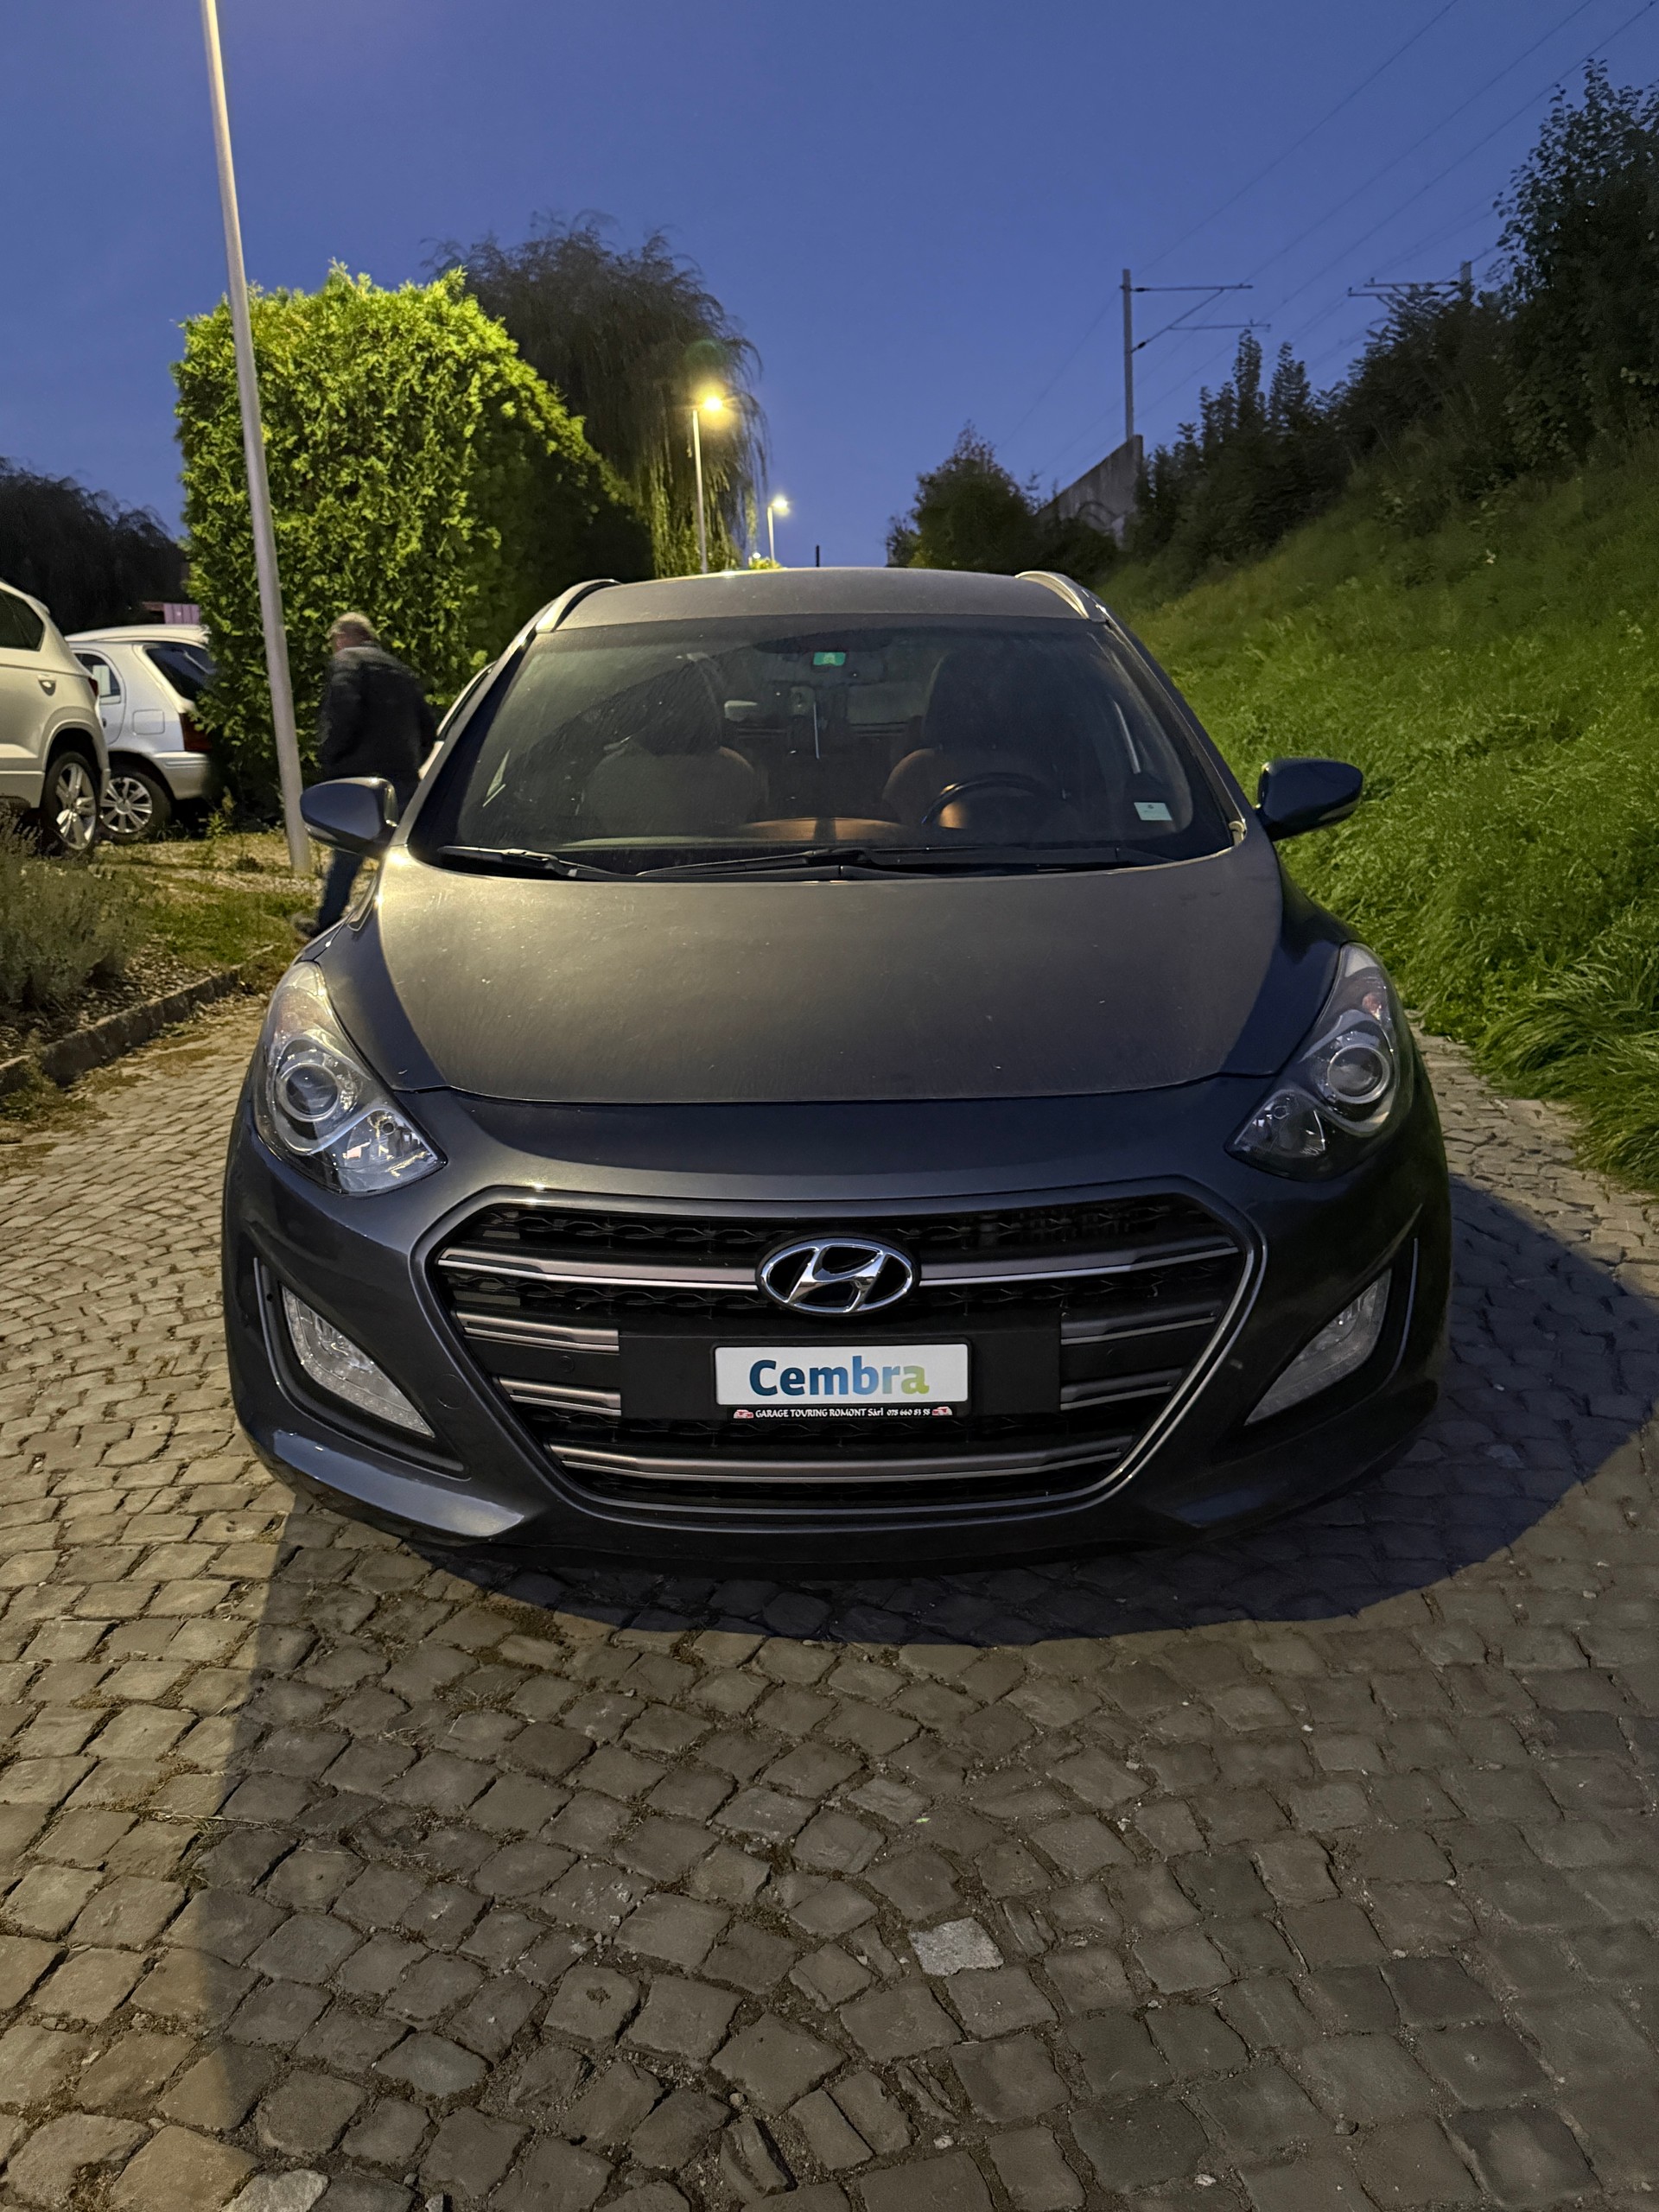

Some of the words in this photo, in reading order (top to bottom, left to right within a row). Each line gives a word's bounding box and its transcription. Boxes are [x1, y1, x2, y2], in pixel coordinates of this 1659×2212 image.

[749, 1356, 930, 1396] Cembra
[755, 1409, 789, 1418] GARAGE
[791, 1408, 828, 1417] TOURING
[829, 1408, 867, 1417] ROMONT
